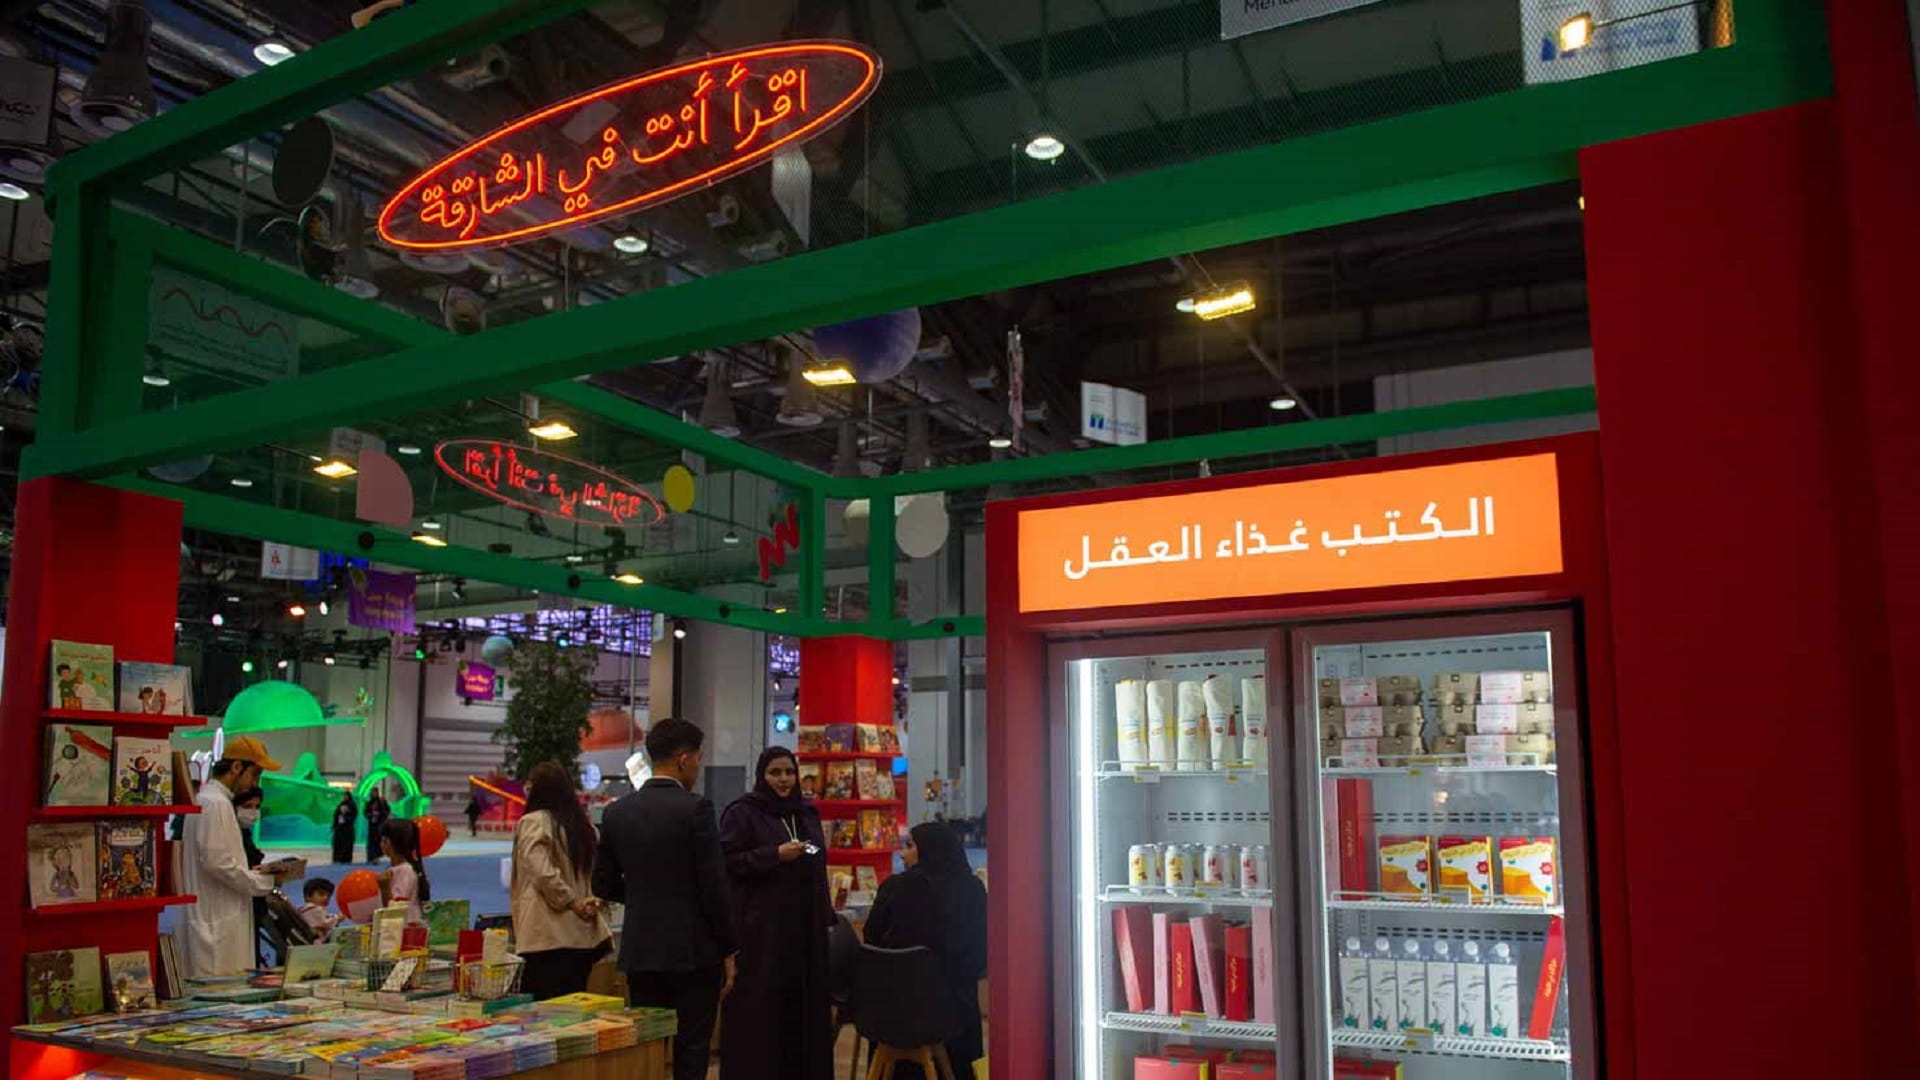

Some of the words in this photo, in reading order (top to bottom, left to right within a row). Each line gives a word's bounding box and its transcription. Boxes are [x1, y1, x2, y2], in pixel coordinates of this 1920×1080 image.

[632, 70, 714, 164] أنت
[727, 62, 808, 151] اقرأ
[420, 153, 546, 238] الشارقة
[557, 127, 617, 212] في
[1064, 524, 1202, 580] العقل
[1214, 519, 1310, 559] غذاء
[1320, 496, 1495, 557] الكتب
